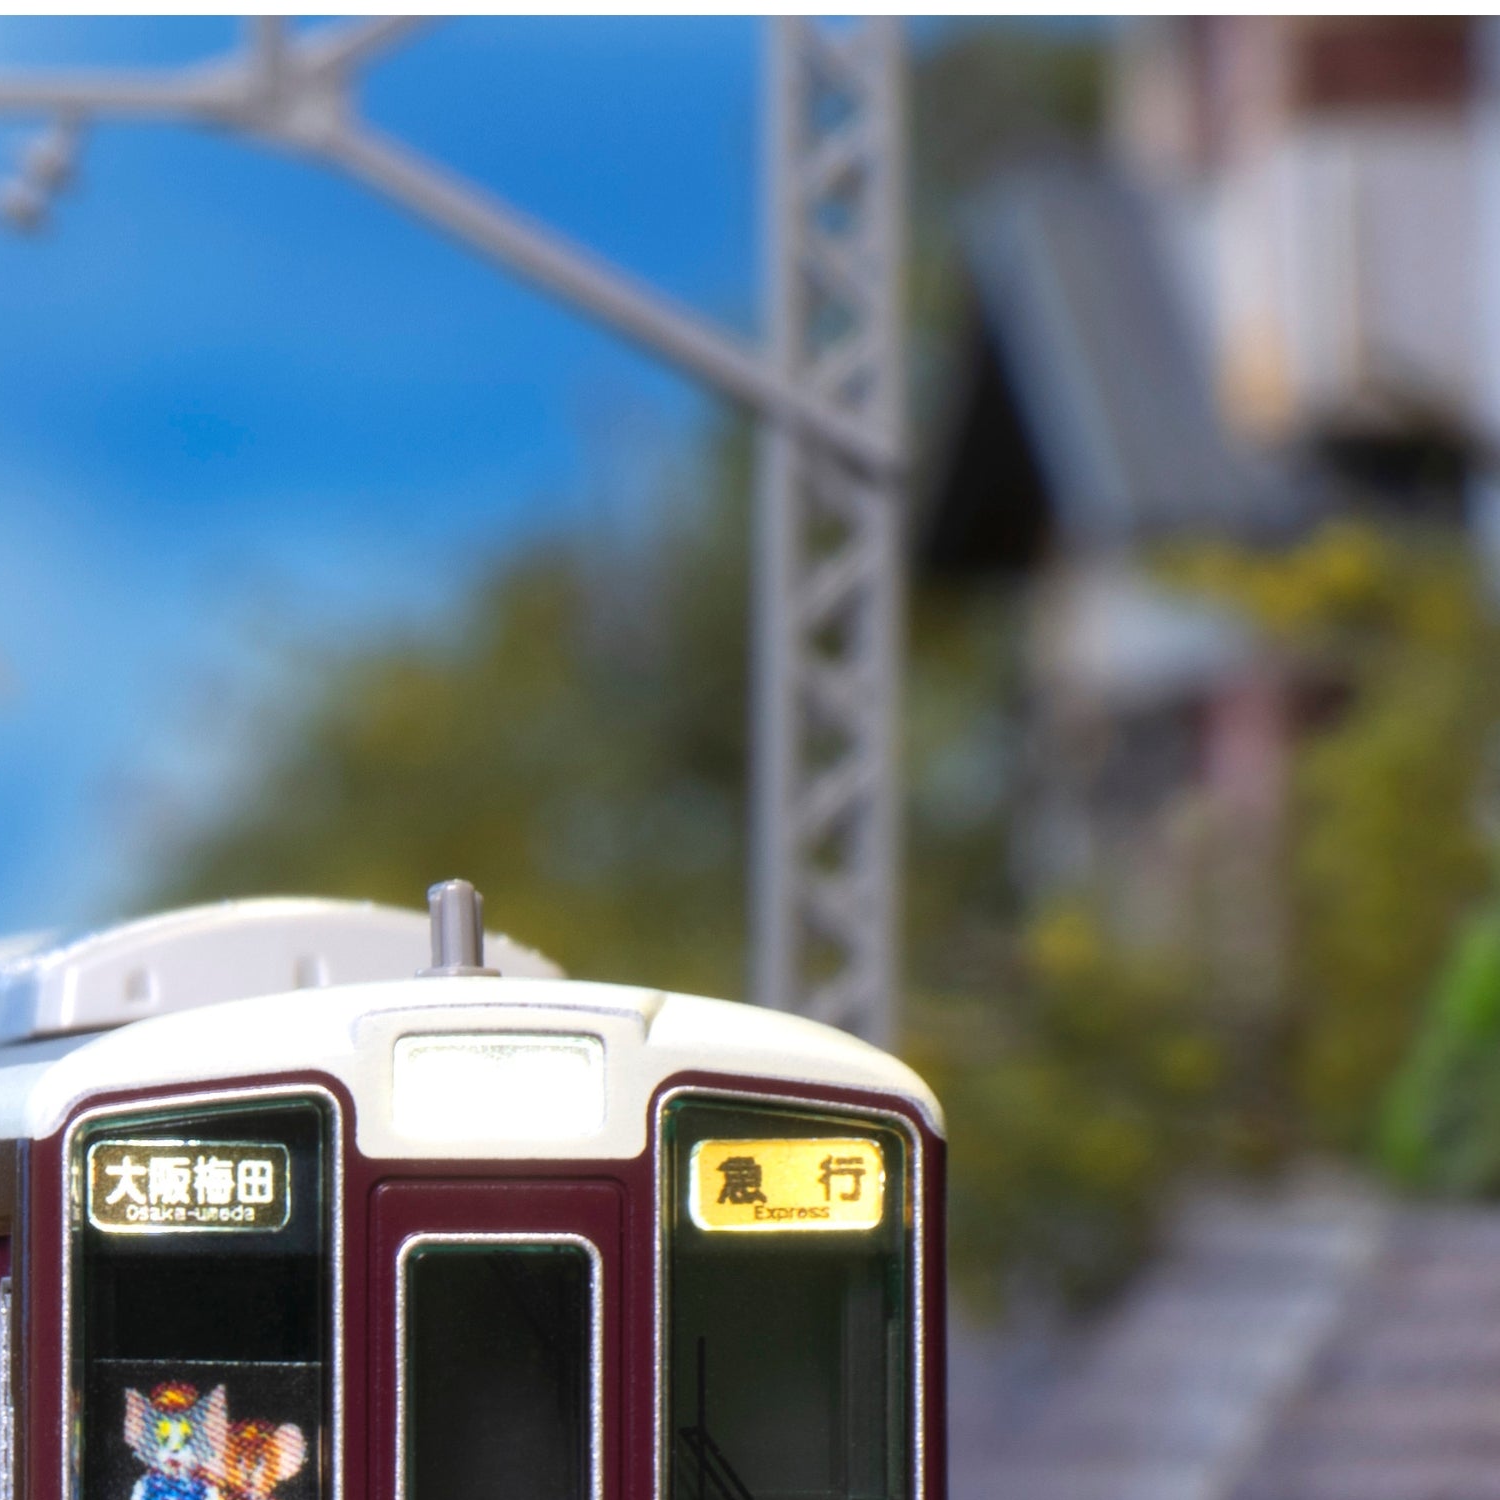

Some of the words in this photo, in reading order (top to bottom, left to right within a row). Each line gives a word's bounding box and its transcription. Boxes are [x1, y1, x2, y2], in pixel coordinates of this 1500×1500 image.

[104, 1155, 274, 1205] 大阪梅田
[716, 1154, 866, 1204] 急行
[753, 1205, 830, 1221] Express
